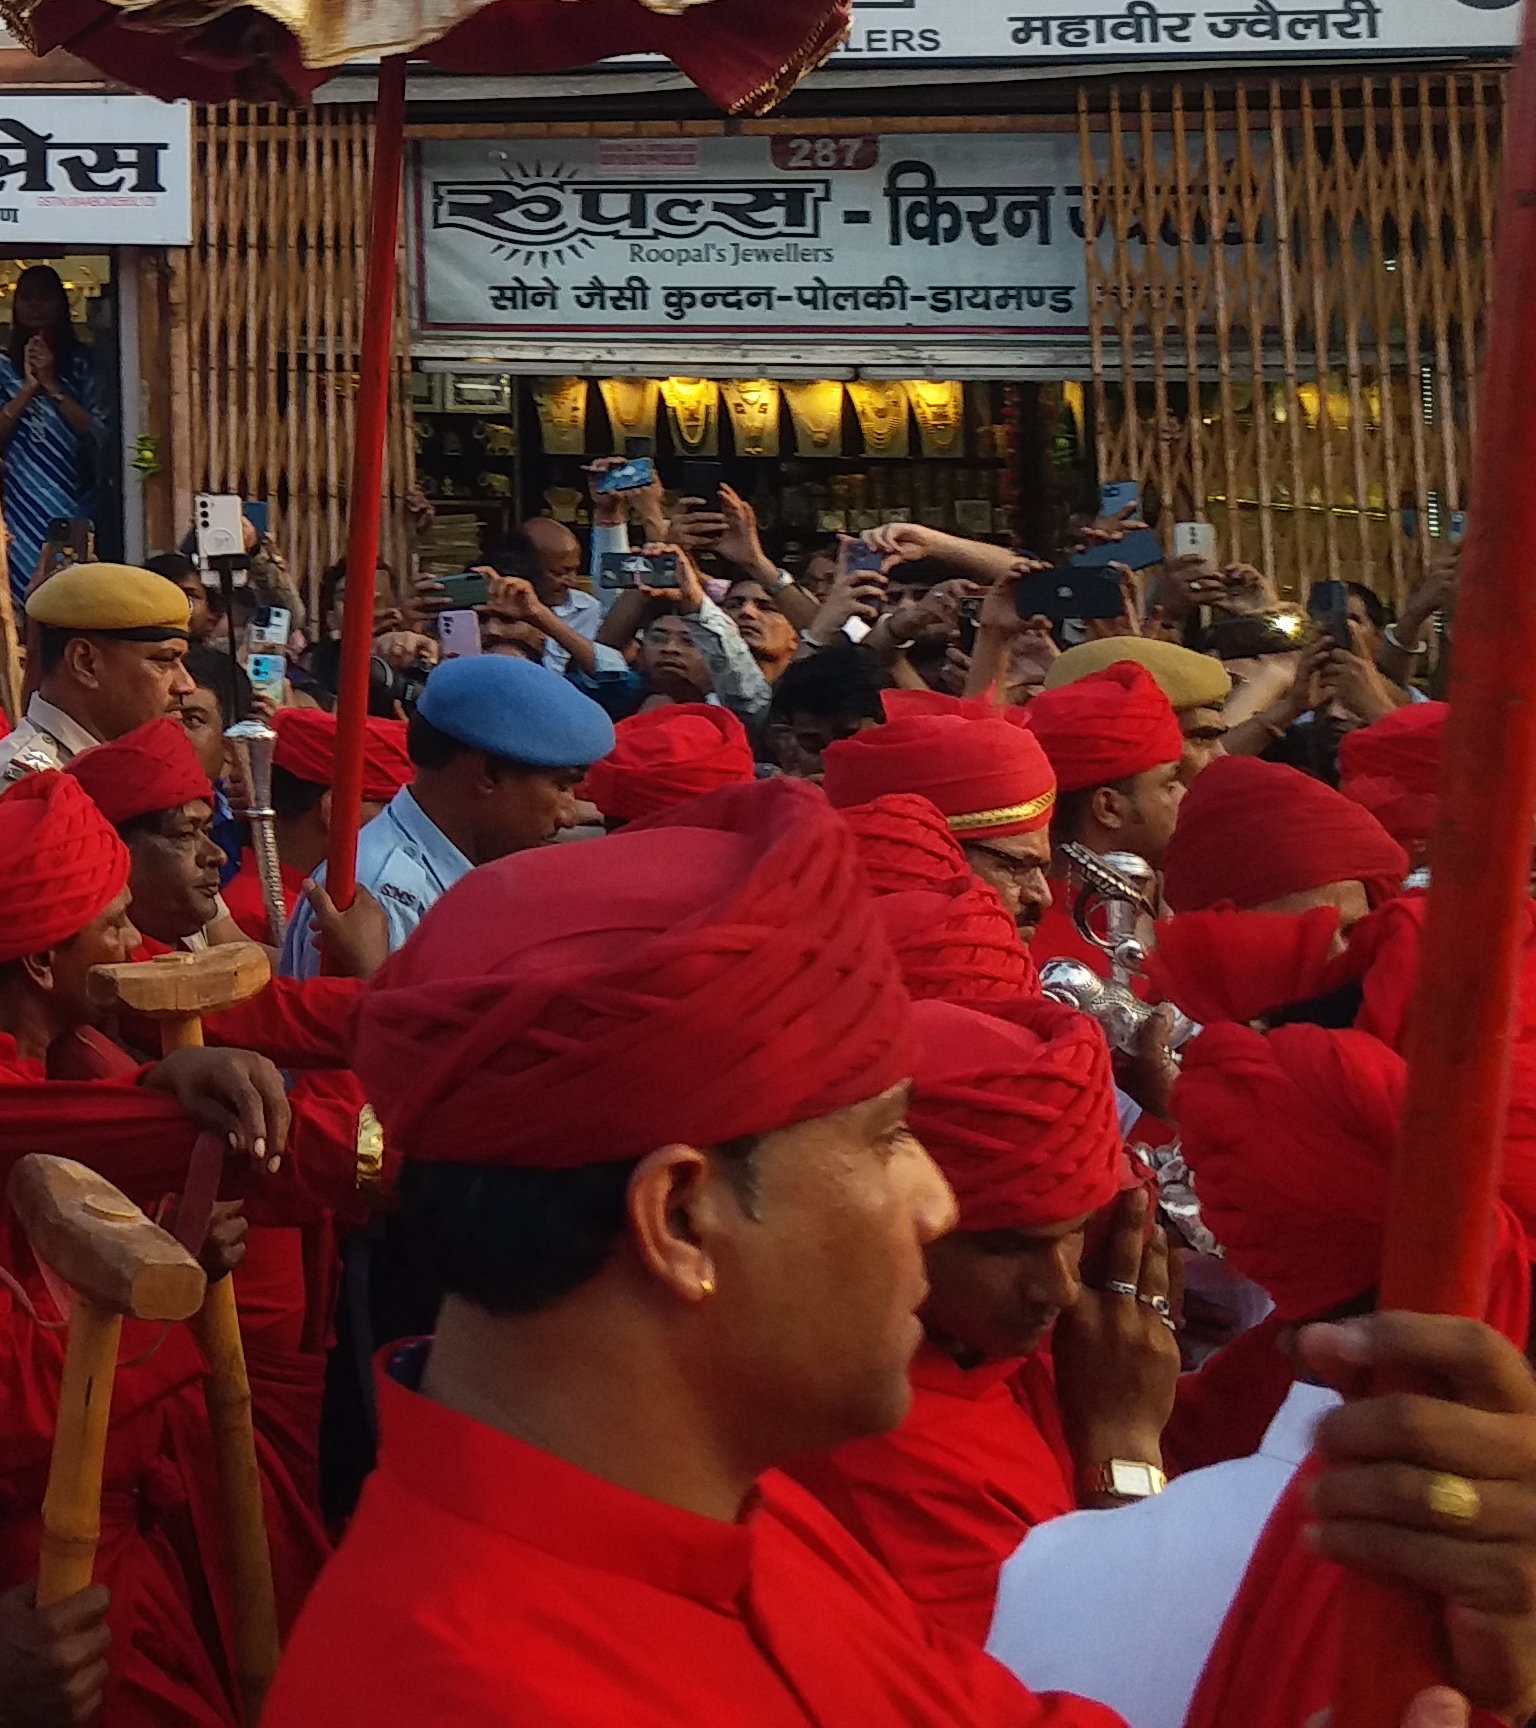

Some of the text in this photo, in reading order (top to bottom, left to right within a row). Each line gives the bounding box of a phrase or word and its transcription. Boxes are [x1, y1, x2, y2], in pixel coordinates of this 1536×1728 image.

[1007, 0, 1196, 48] महावीर
[787, 138, 864, 168] 287
[883, 160, 1055, 246] किरन
[628, 243, 834, 267] Roopal's Jewellers
[489, 275, 560, 311] सोने
[571, 275, 651, 311] जैसी
